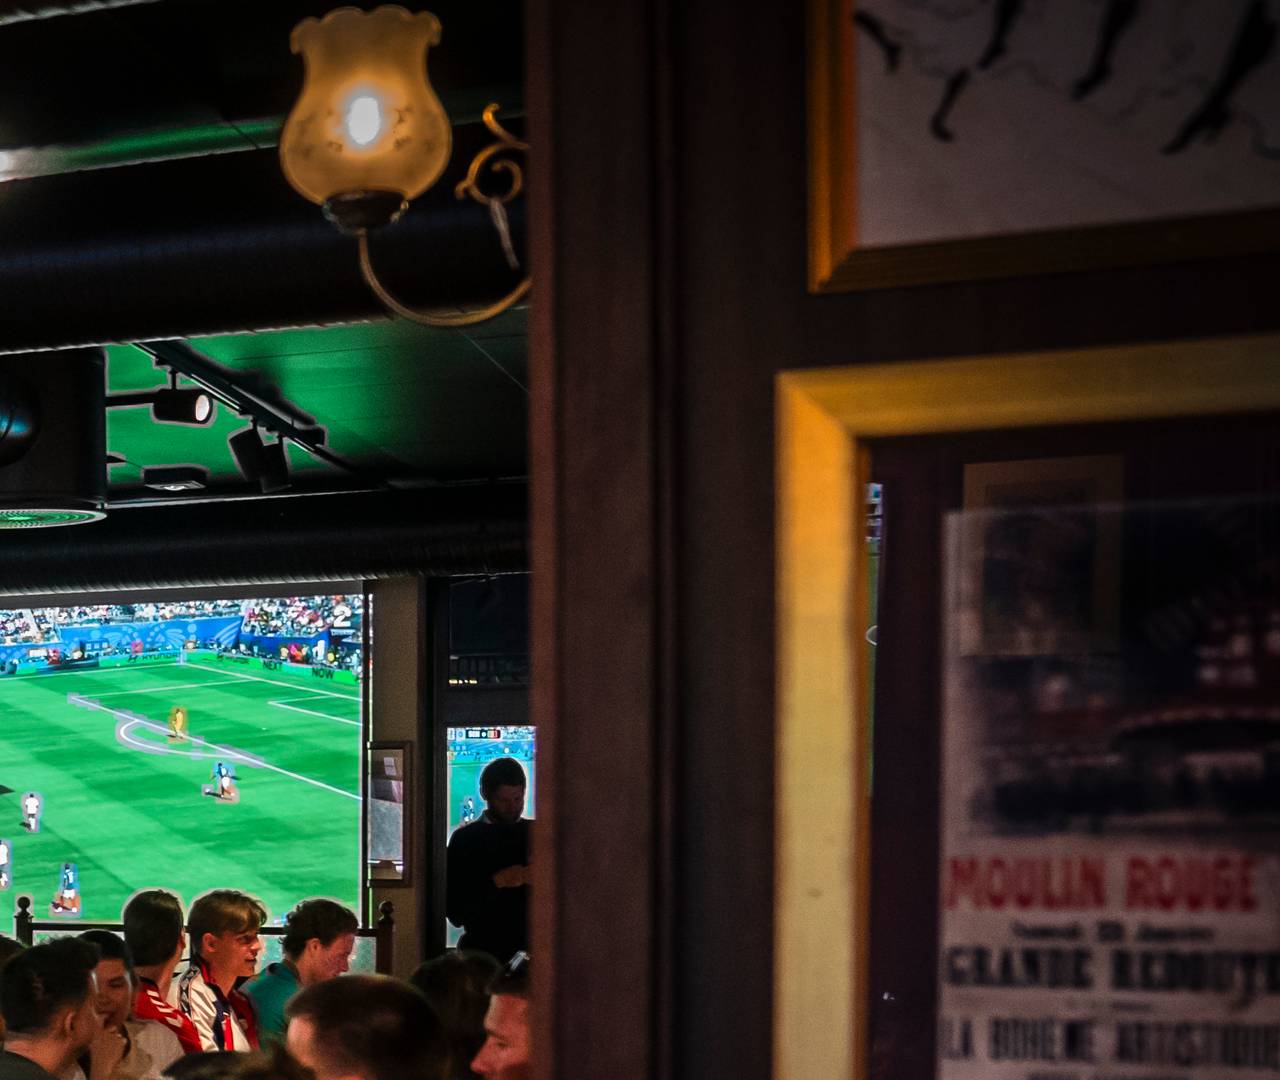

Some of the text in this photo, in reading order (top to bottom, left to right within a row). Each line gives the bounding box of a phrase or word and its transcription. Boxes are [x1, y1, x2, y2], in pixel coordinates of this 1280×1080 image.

[263, 660, 282, 672] NEXT
[312, 667, 334, 679] NOW
[945, 856, 1258, 912] MOULIN ROUGE
